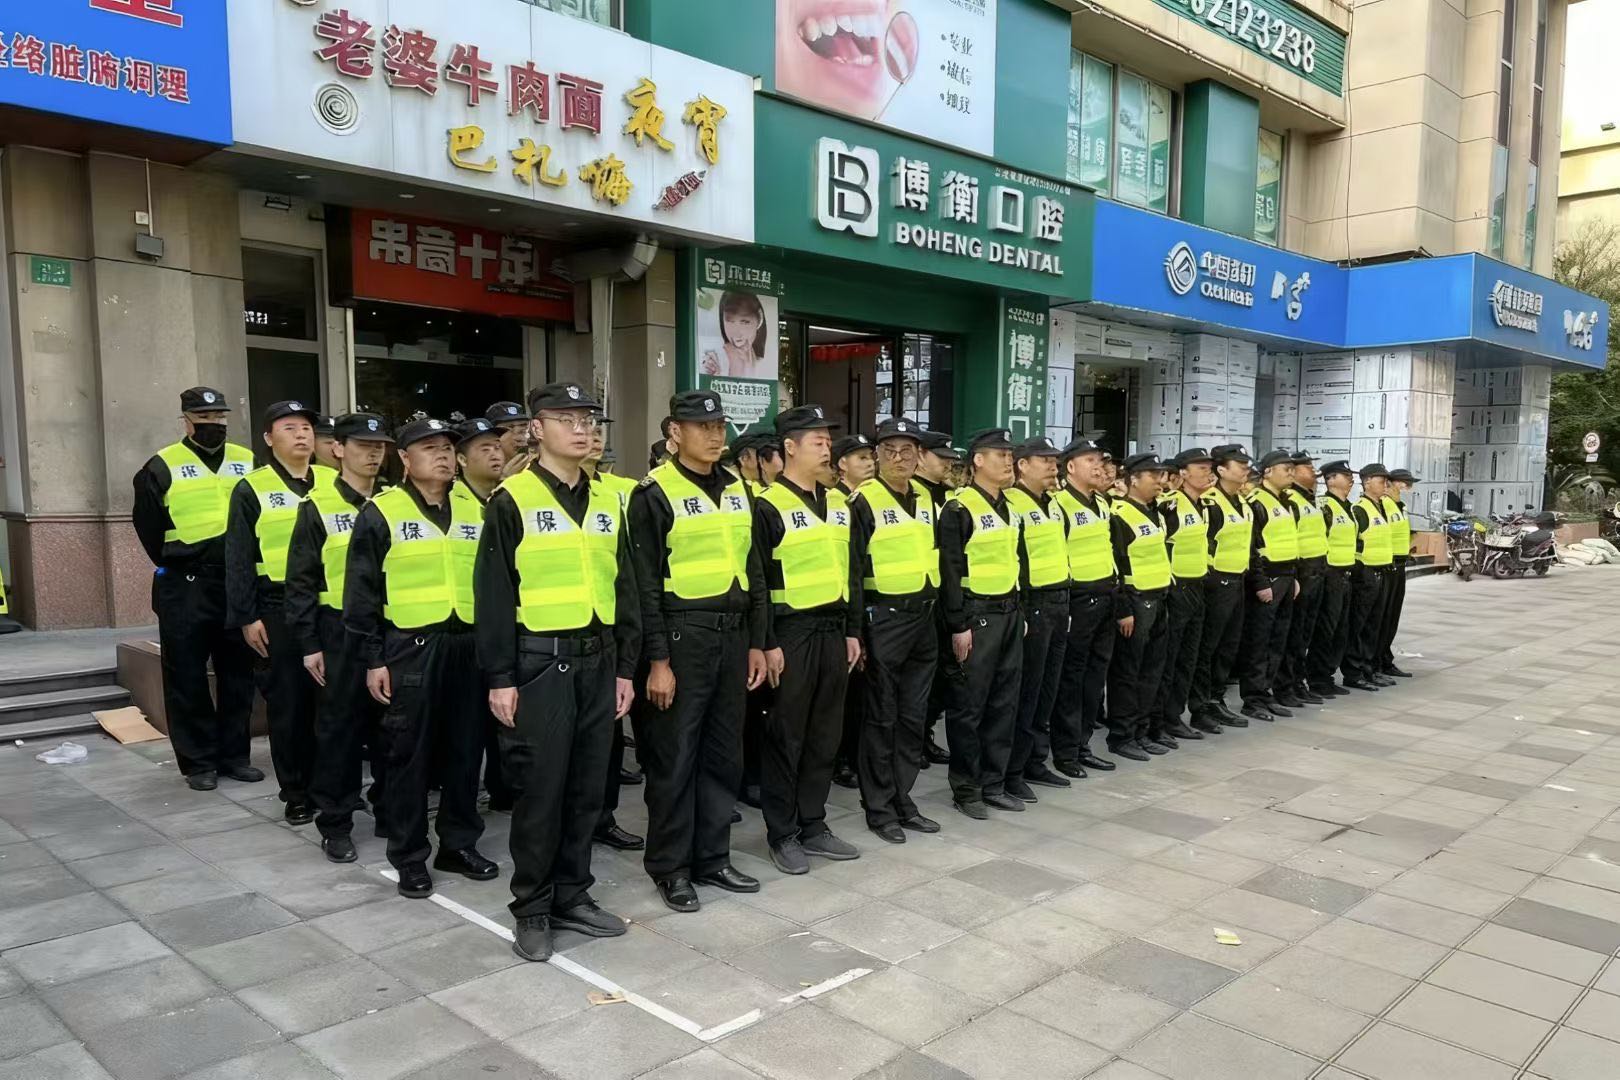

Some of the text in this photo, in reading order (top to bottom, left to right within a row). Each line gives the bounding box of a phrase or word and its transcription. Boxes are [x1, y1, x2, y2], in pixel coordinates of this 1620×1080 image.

[314, 9, 604, 135] 老婆牛肉面
[894, 157, 1065, 242] 博衡口腔
[896, 222, 1064, 276] BOHENG DENTAL
